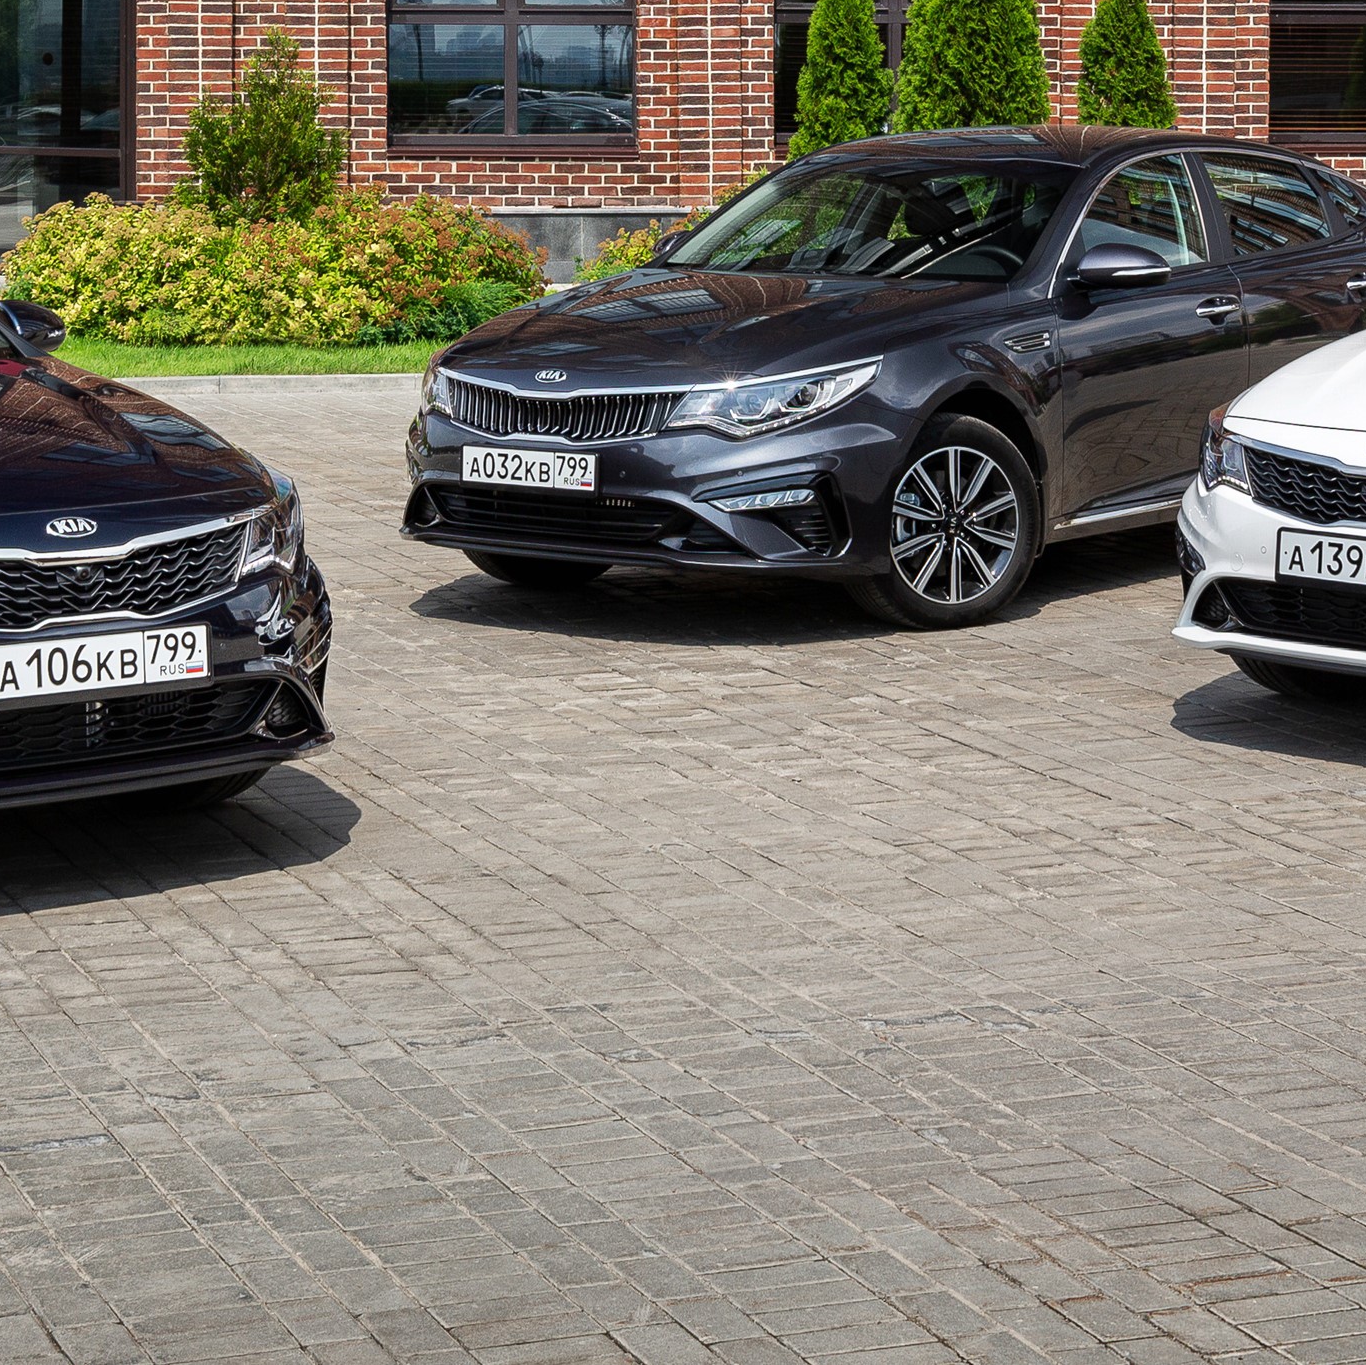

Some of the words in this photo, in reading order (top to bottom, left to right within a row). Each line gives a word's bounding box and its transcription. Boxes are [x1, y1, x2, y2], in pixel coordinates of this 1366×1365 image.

[537, 370, 565, 382] KIA
[556, 455, 589, 478] 799
[563, 477, 580, 486] RUS
[53, 518, 93, 534] KIA
[146, 631, 196, 665] 799
[160, 663, 185, 676] RUS
